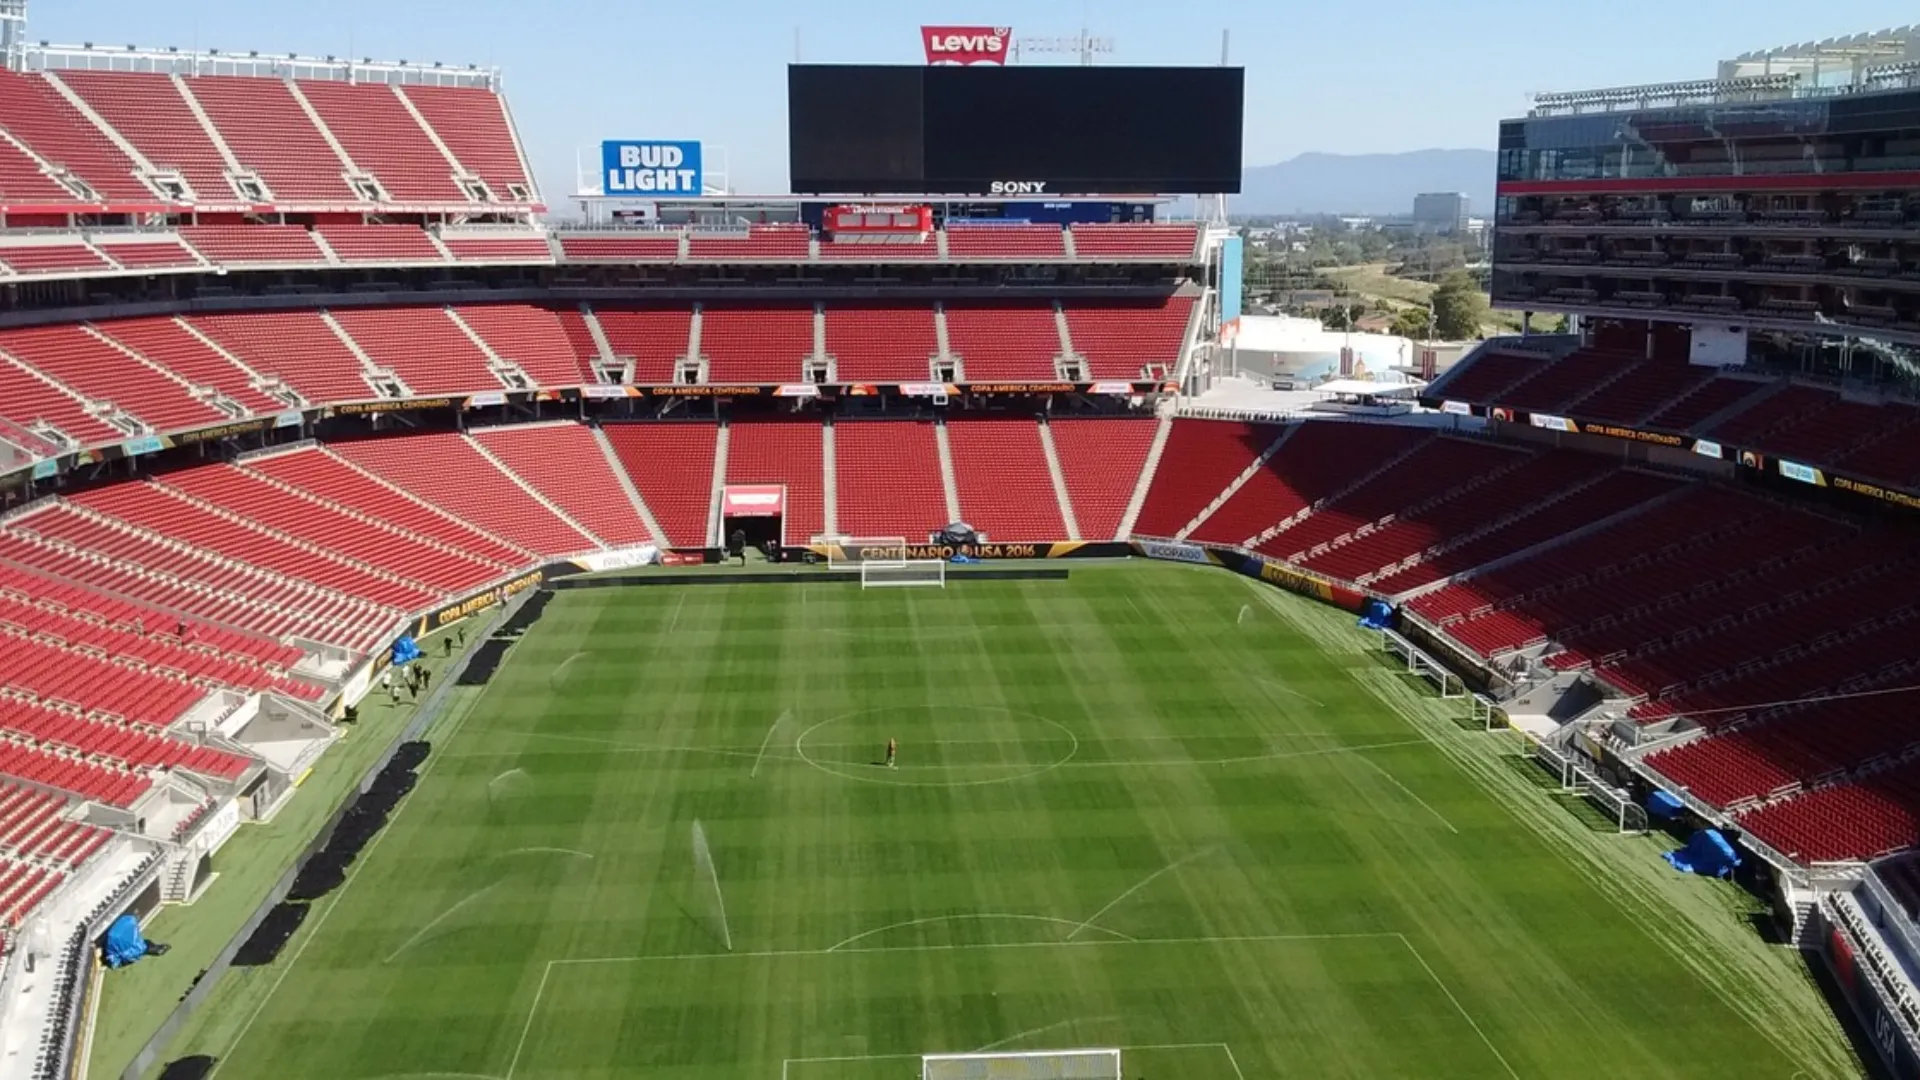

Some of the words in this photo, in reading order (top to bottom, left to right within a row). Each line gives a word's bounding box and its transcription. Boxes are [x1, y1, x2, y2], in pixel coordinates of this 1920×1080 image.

[620, 145, 683, 168] BUD
[609, 169, 696, 190] LIGHT
[990, 181, 1046, 194] SONY
[652, 387, 673, 395] COPA
[675, 387, 711, 395] AMERICA
[340, 405, 362, 414] COPA
[365, 402, 400, 412] AMERICA
[974, 545, 1001, 558] USA
[1006, 545, 1035, 558] 2016
[438, 604, 461, 624] COPA
[461, 590, 496, 616] AMERICA
[1875, 1007, 1896, 1064] USA
